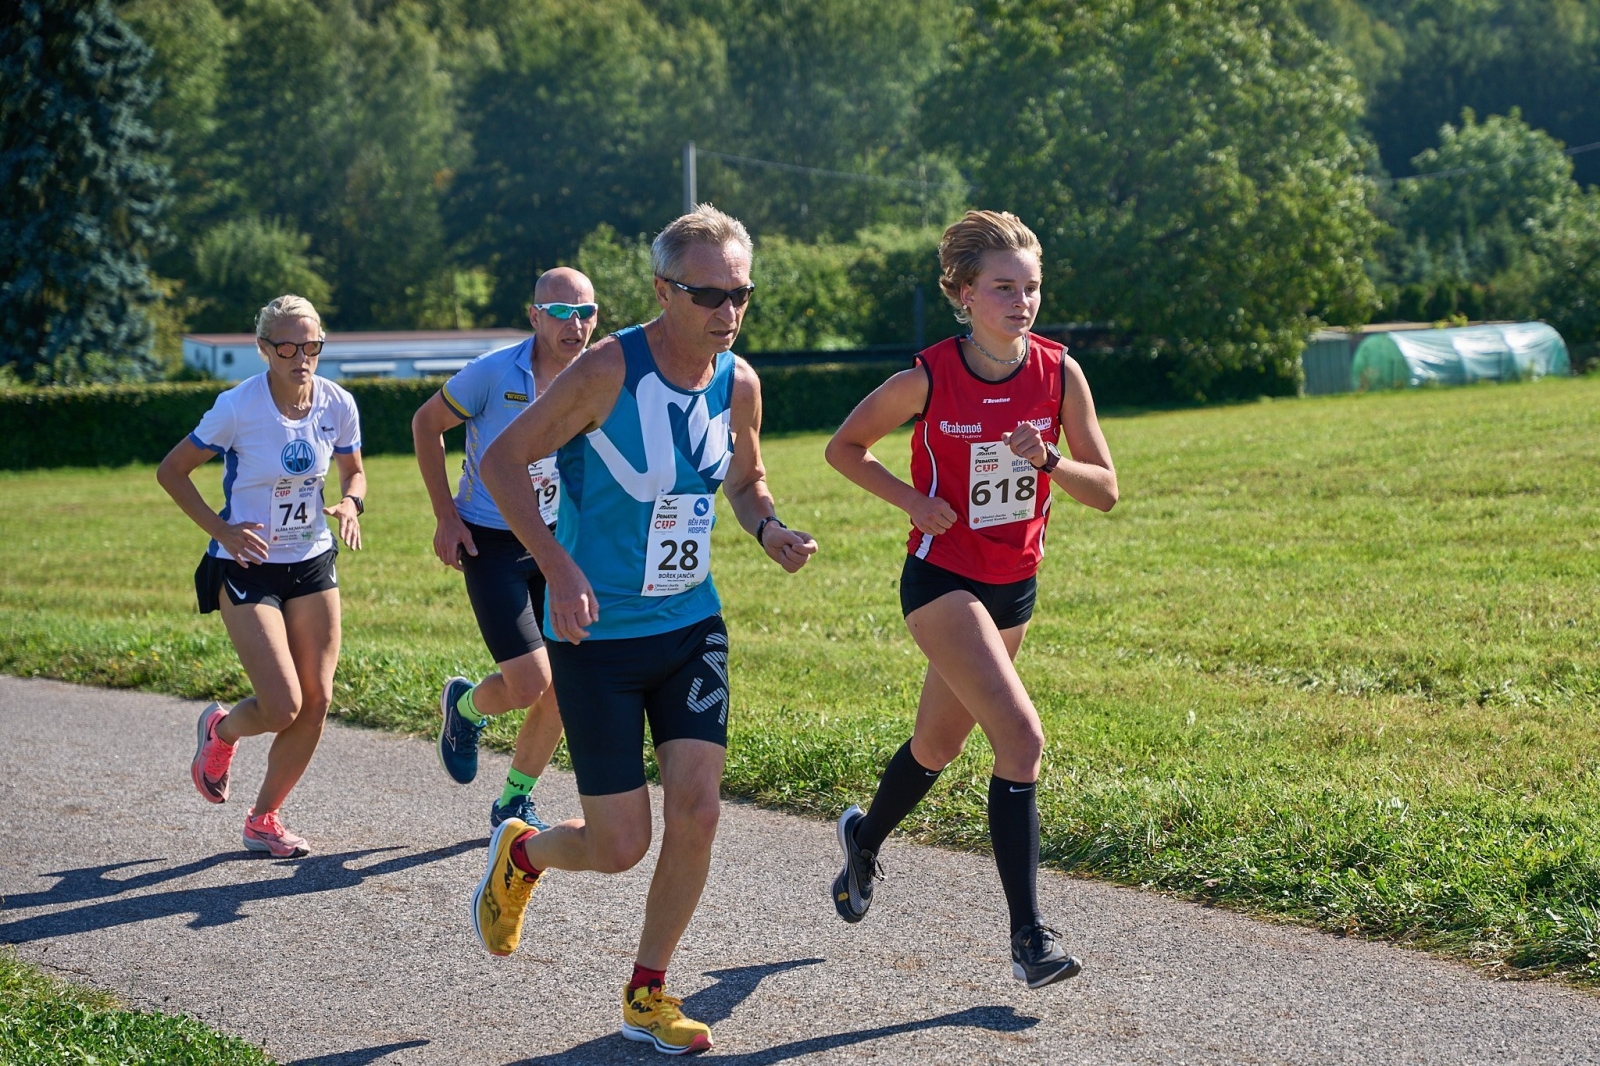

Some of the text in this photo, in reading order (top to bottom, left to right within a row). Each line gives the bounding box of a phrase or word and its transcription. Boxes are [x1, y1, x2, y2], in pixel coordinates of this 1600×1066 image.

[940, 420, 982, 434] Krakonoš
[974, 464, 999, 473] CUP
[274, 490, 291, 498] CUP
[971, 475, 1036, 506] 618
[279, 501, 308, 526] 74
[654, 520, 677, 529] CUP
[688, 517, 699, 526] BĚH
[658, 539, 699, 570] 28
